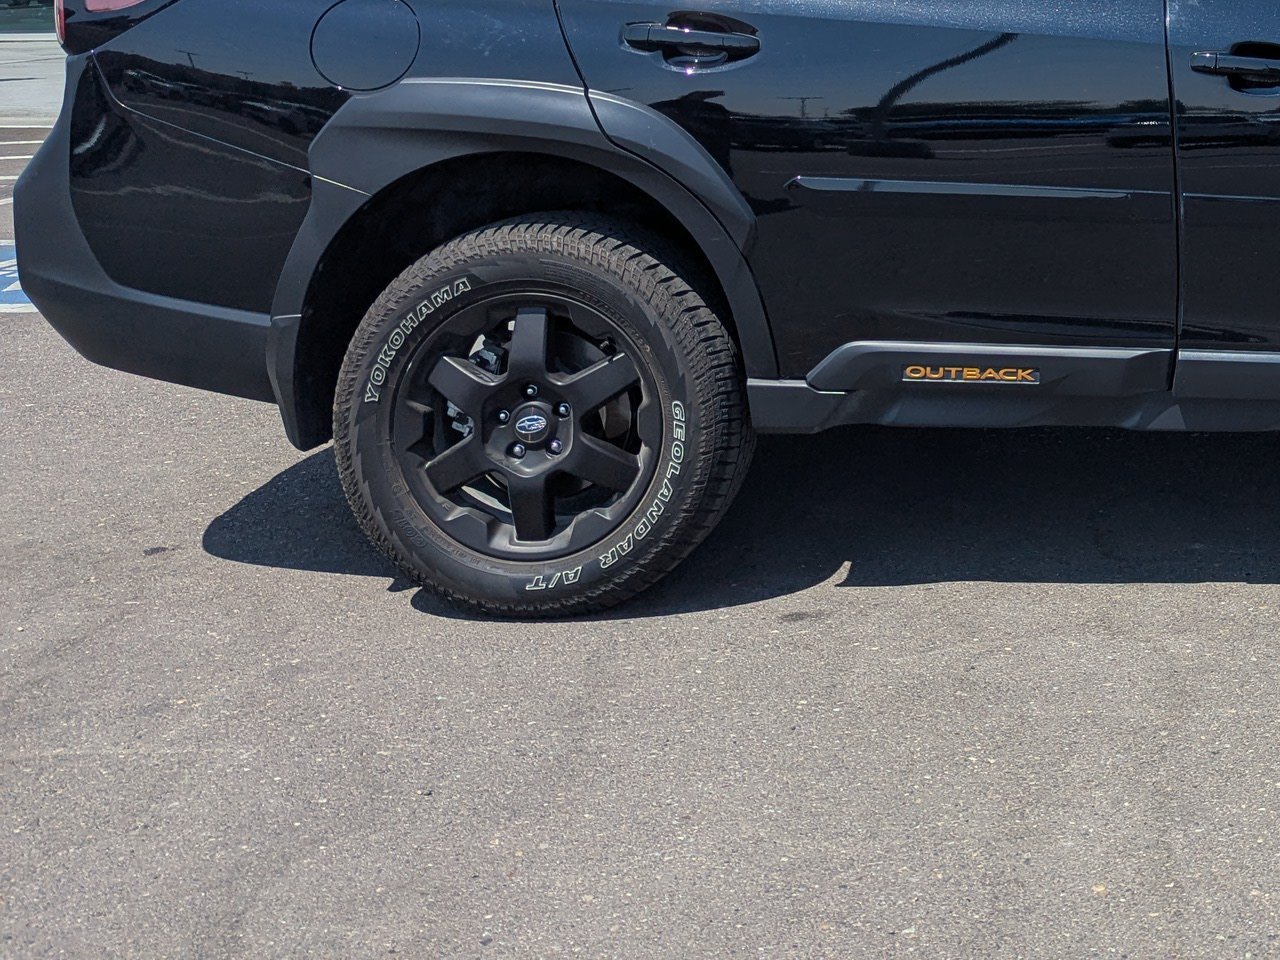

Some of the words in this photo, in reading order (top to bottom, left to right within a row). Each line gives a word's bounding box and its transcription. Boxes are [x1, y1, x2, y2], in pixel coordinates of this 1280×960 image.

[364, 277, 472, 403] YOKOHAMA
[904, 365, 1035, 381] OUTBACK
[600, 399, 687, 570] GEOLANDAR
[525, 566, 583, 591] A/T
